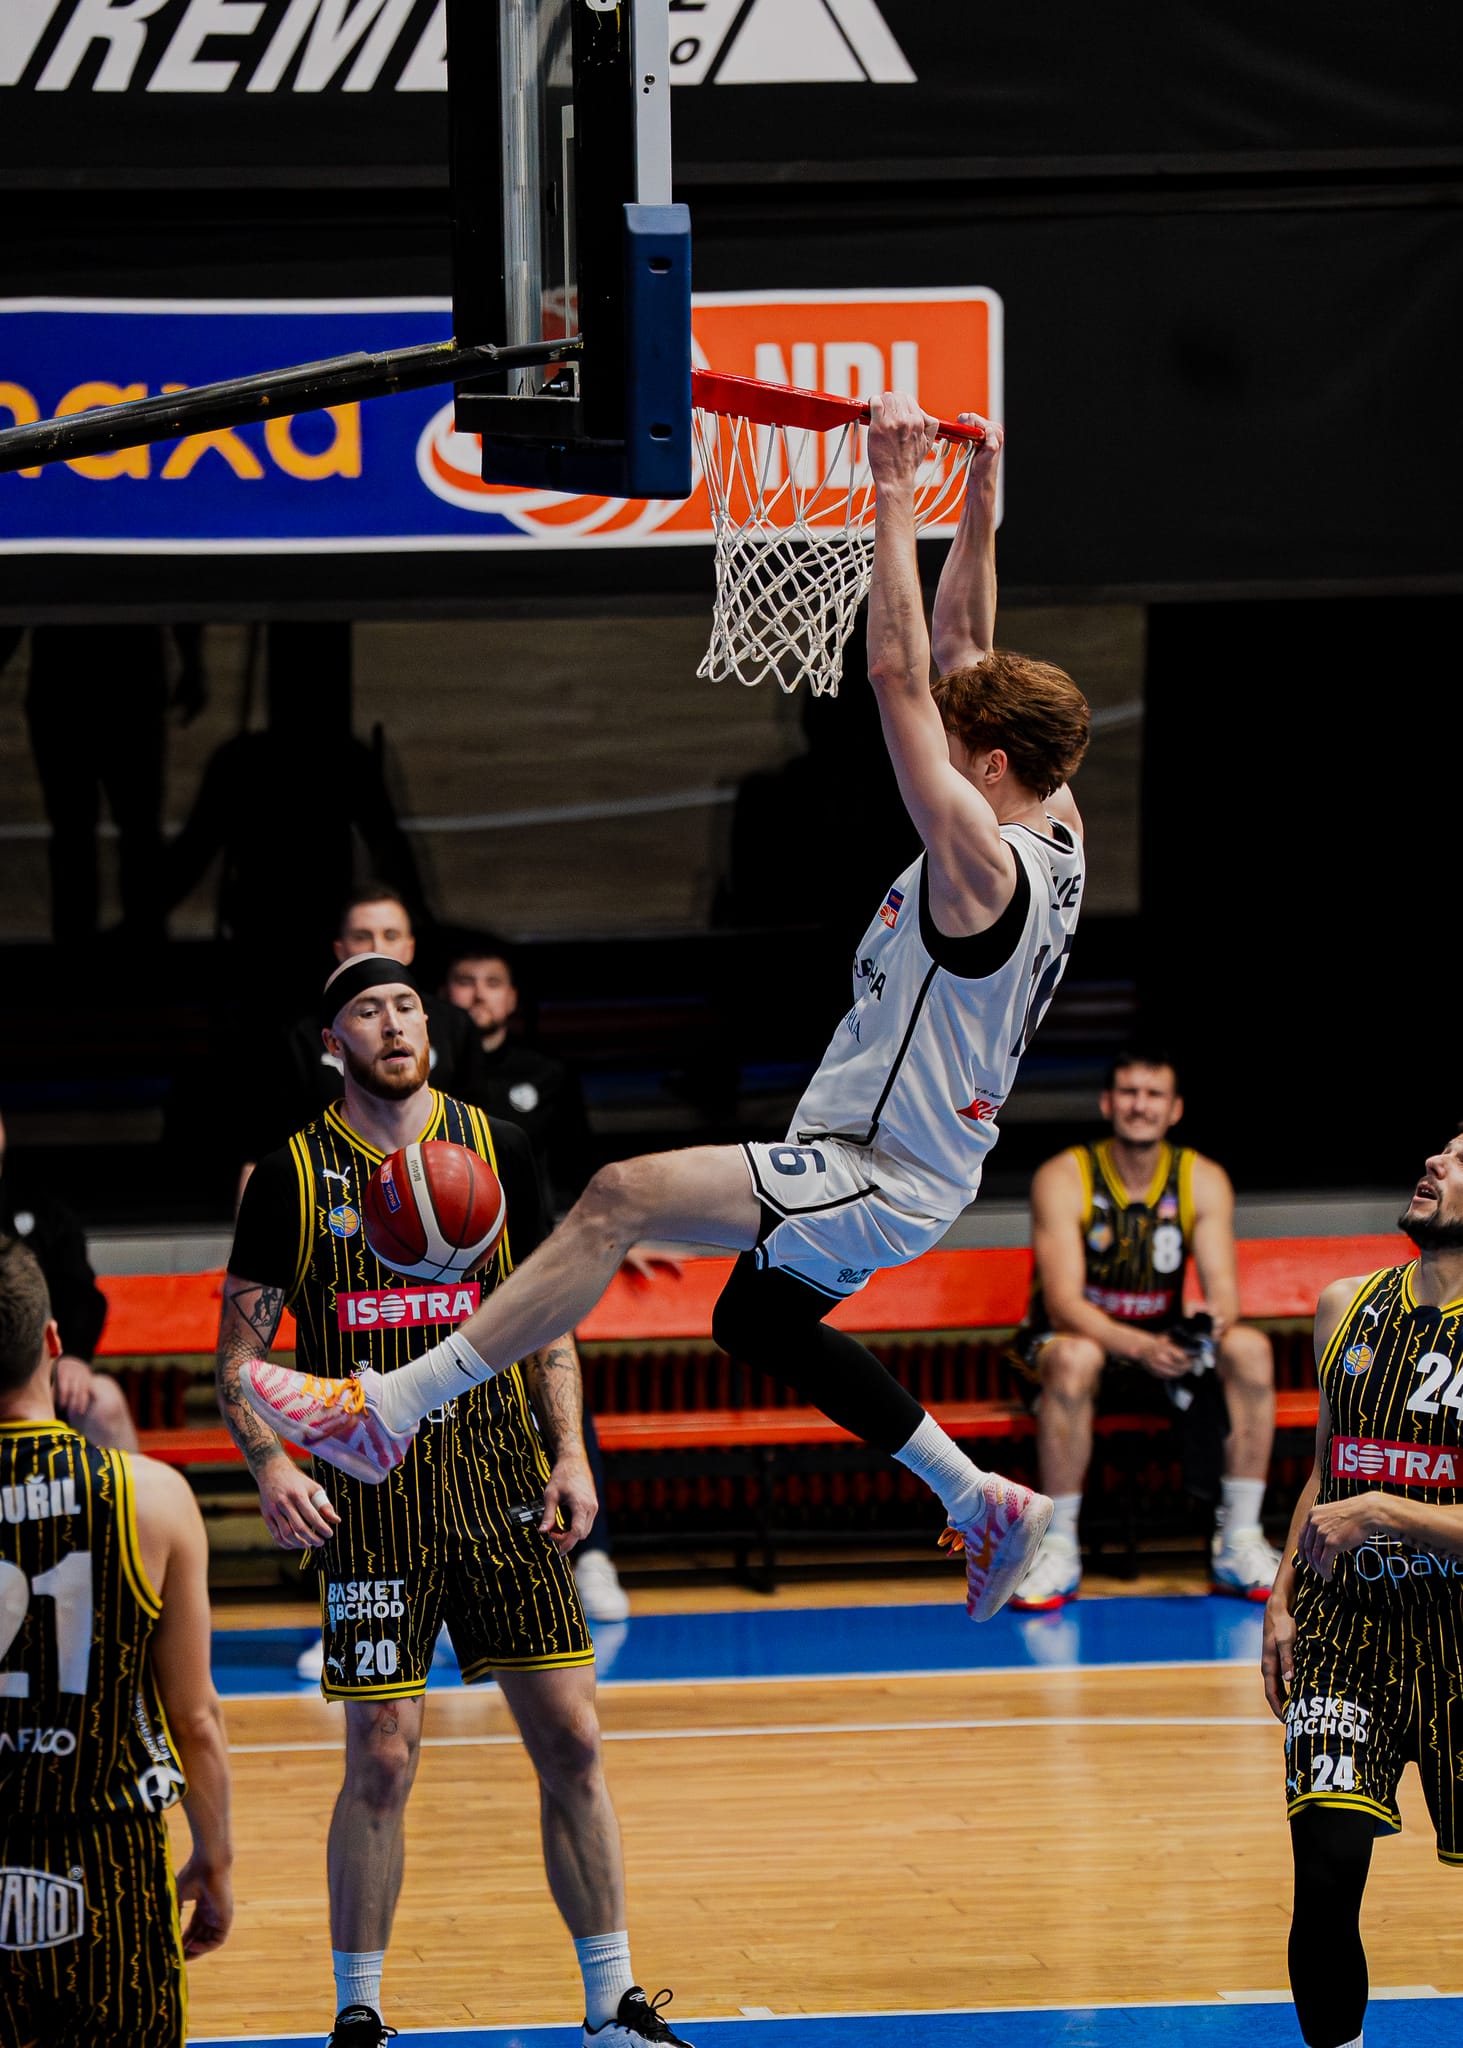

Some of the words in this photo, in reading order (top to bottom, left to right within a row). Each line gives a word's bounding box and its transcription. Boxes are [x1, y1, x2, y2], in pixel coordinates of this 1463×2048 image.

[1153, 1225, 1183, 1274] 8
[347, 1290, 474, 1326] ISOTRA
[1337, 1442, 1456, 1481] ISOTRA
[0, 1474, 81, 1524] UŘIL
[328, 1580, 404, 1602] BASKET
[354, 1639, 398, 1677] 20
[1286, 1696, 1371, 1726] BASKET
[1311, 1754, 1355, 1792] 24
[0, 1873, 70, 1945] ANO
